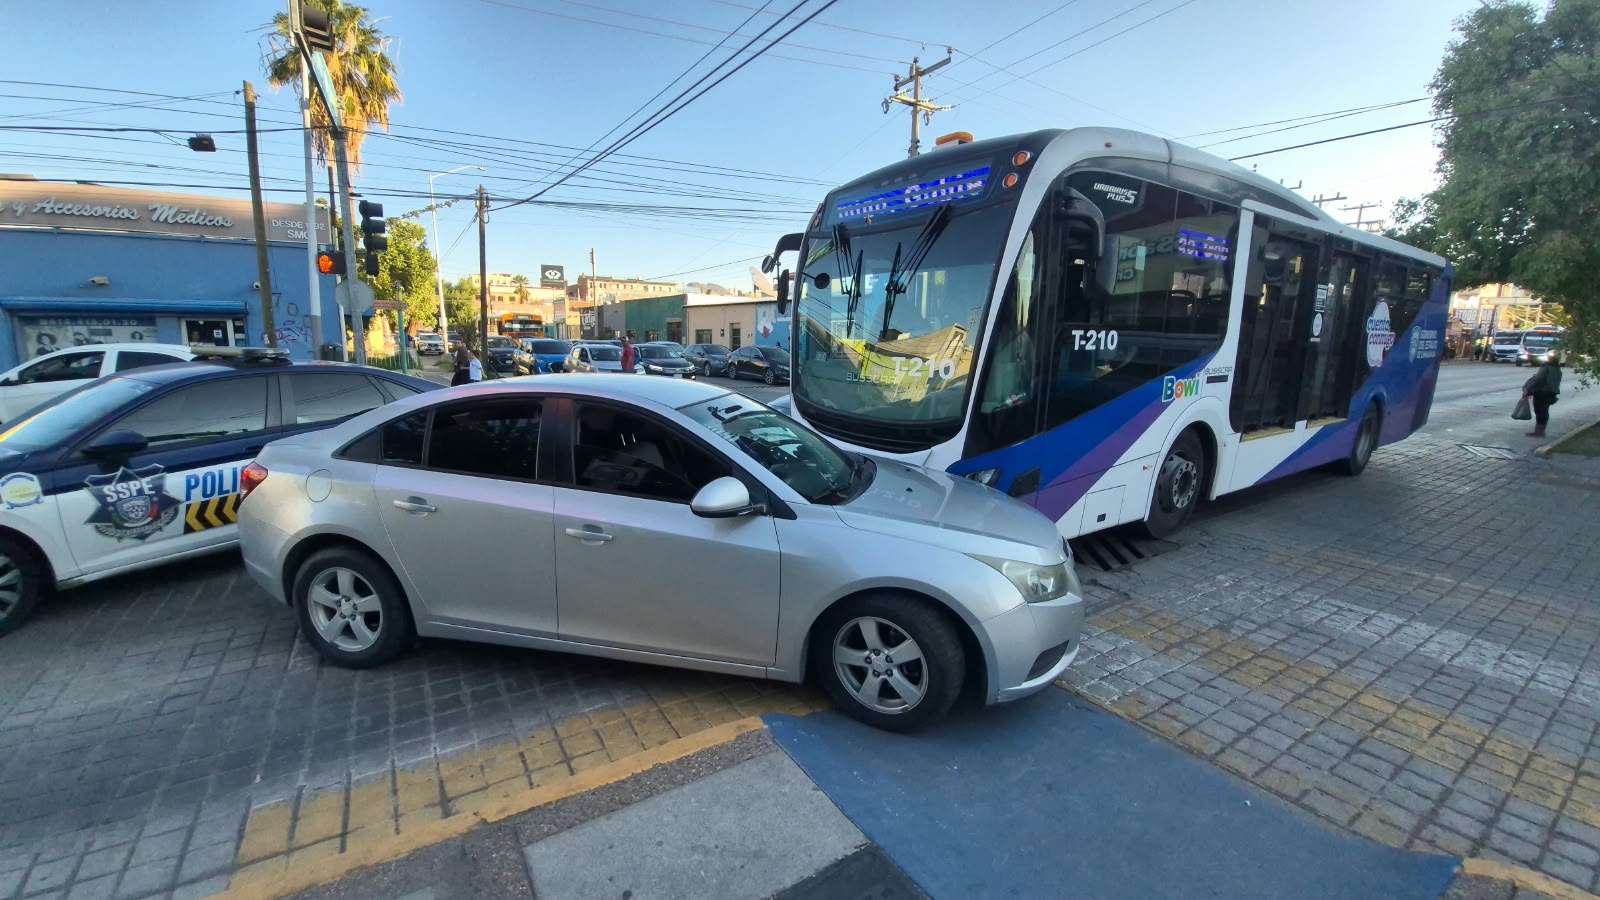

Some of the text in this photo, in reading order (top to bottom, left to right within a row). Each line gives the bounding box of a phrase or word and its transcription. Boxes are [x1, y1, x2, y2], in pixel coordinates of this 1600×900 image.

[13, 200, 26, 216] y
[32, 197, 140, 221] Accesorios
[272, 219, 304, 229] DESDE
[1071, 330, 1118, 351] T-210
[892, 356, 956, 380] T-210
[103, 478, 156, 502] SSPE
